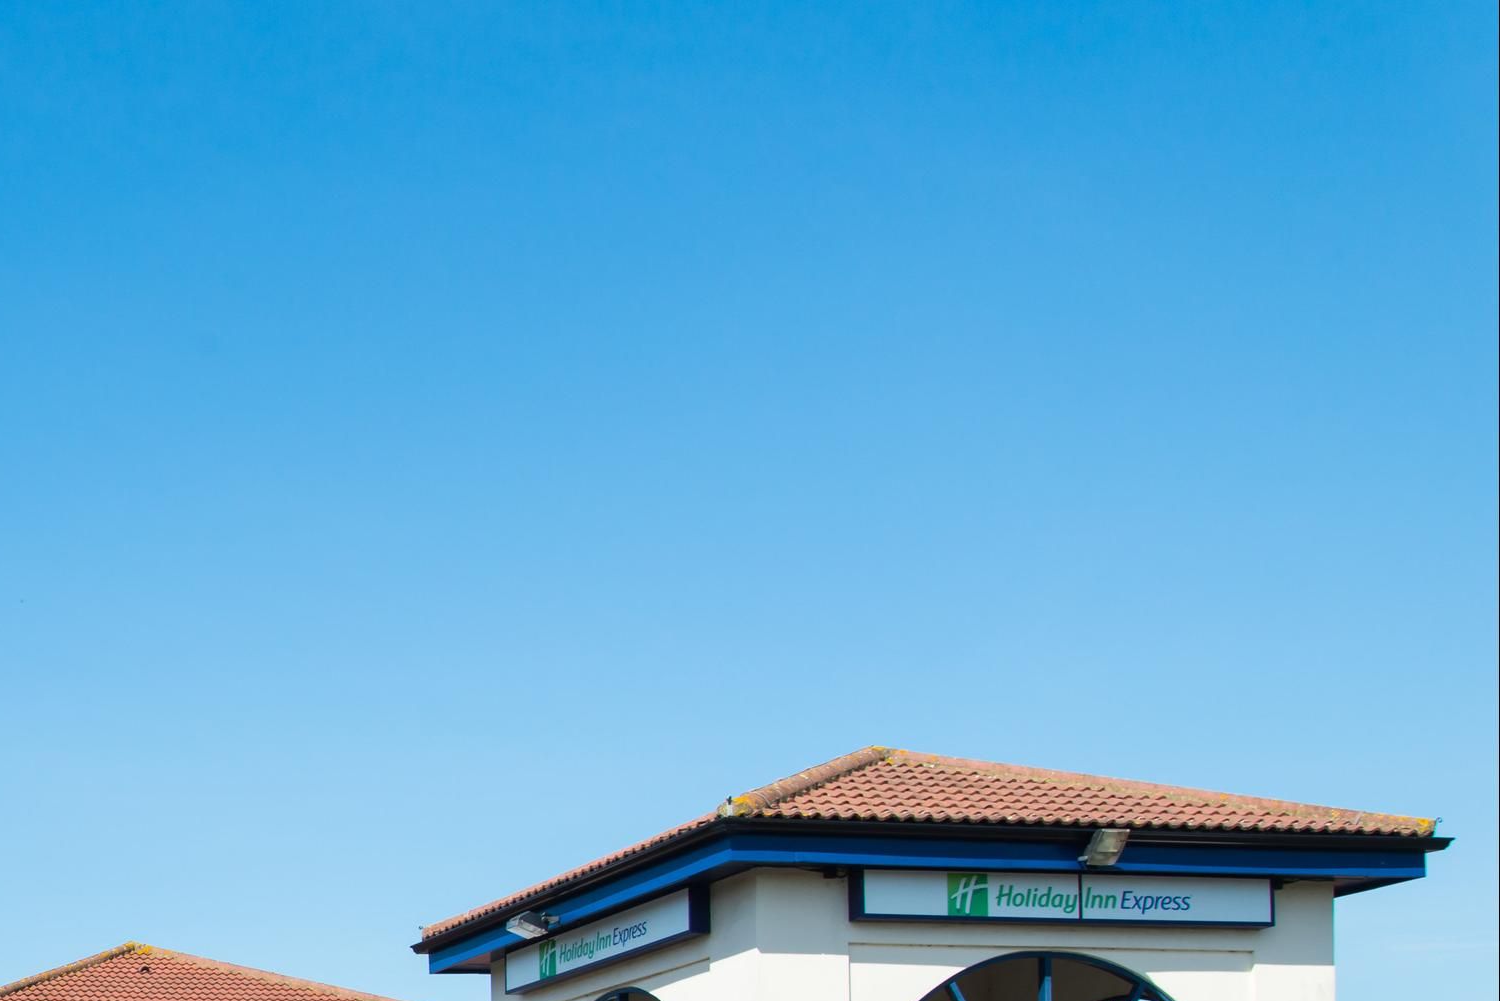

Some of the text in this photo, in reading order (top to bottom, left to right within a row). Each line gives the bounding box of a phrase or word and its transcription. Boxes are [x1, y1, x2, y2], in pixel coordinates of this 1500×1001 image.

[996, 884, 1191, 915] Holiday Inn Express
[559, 921, 647, 963] Holiday Inn Express
